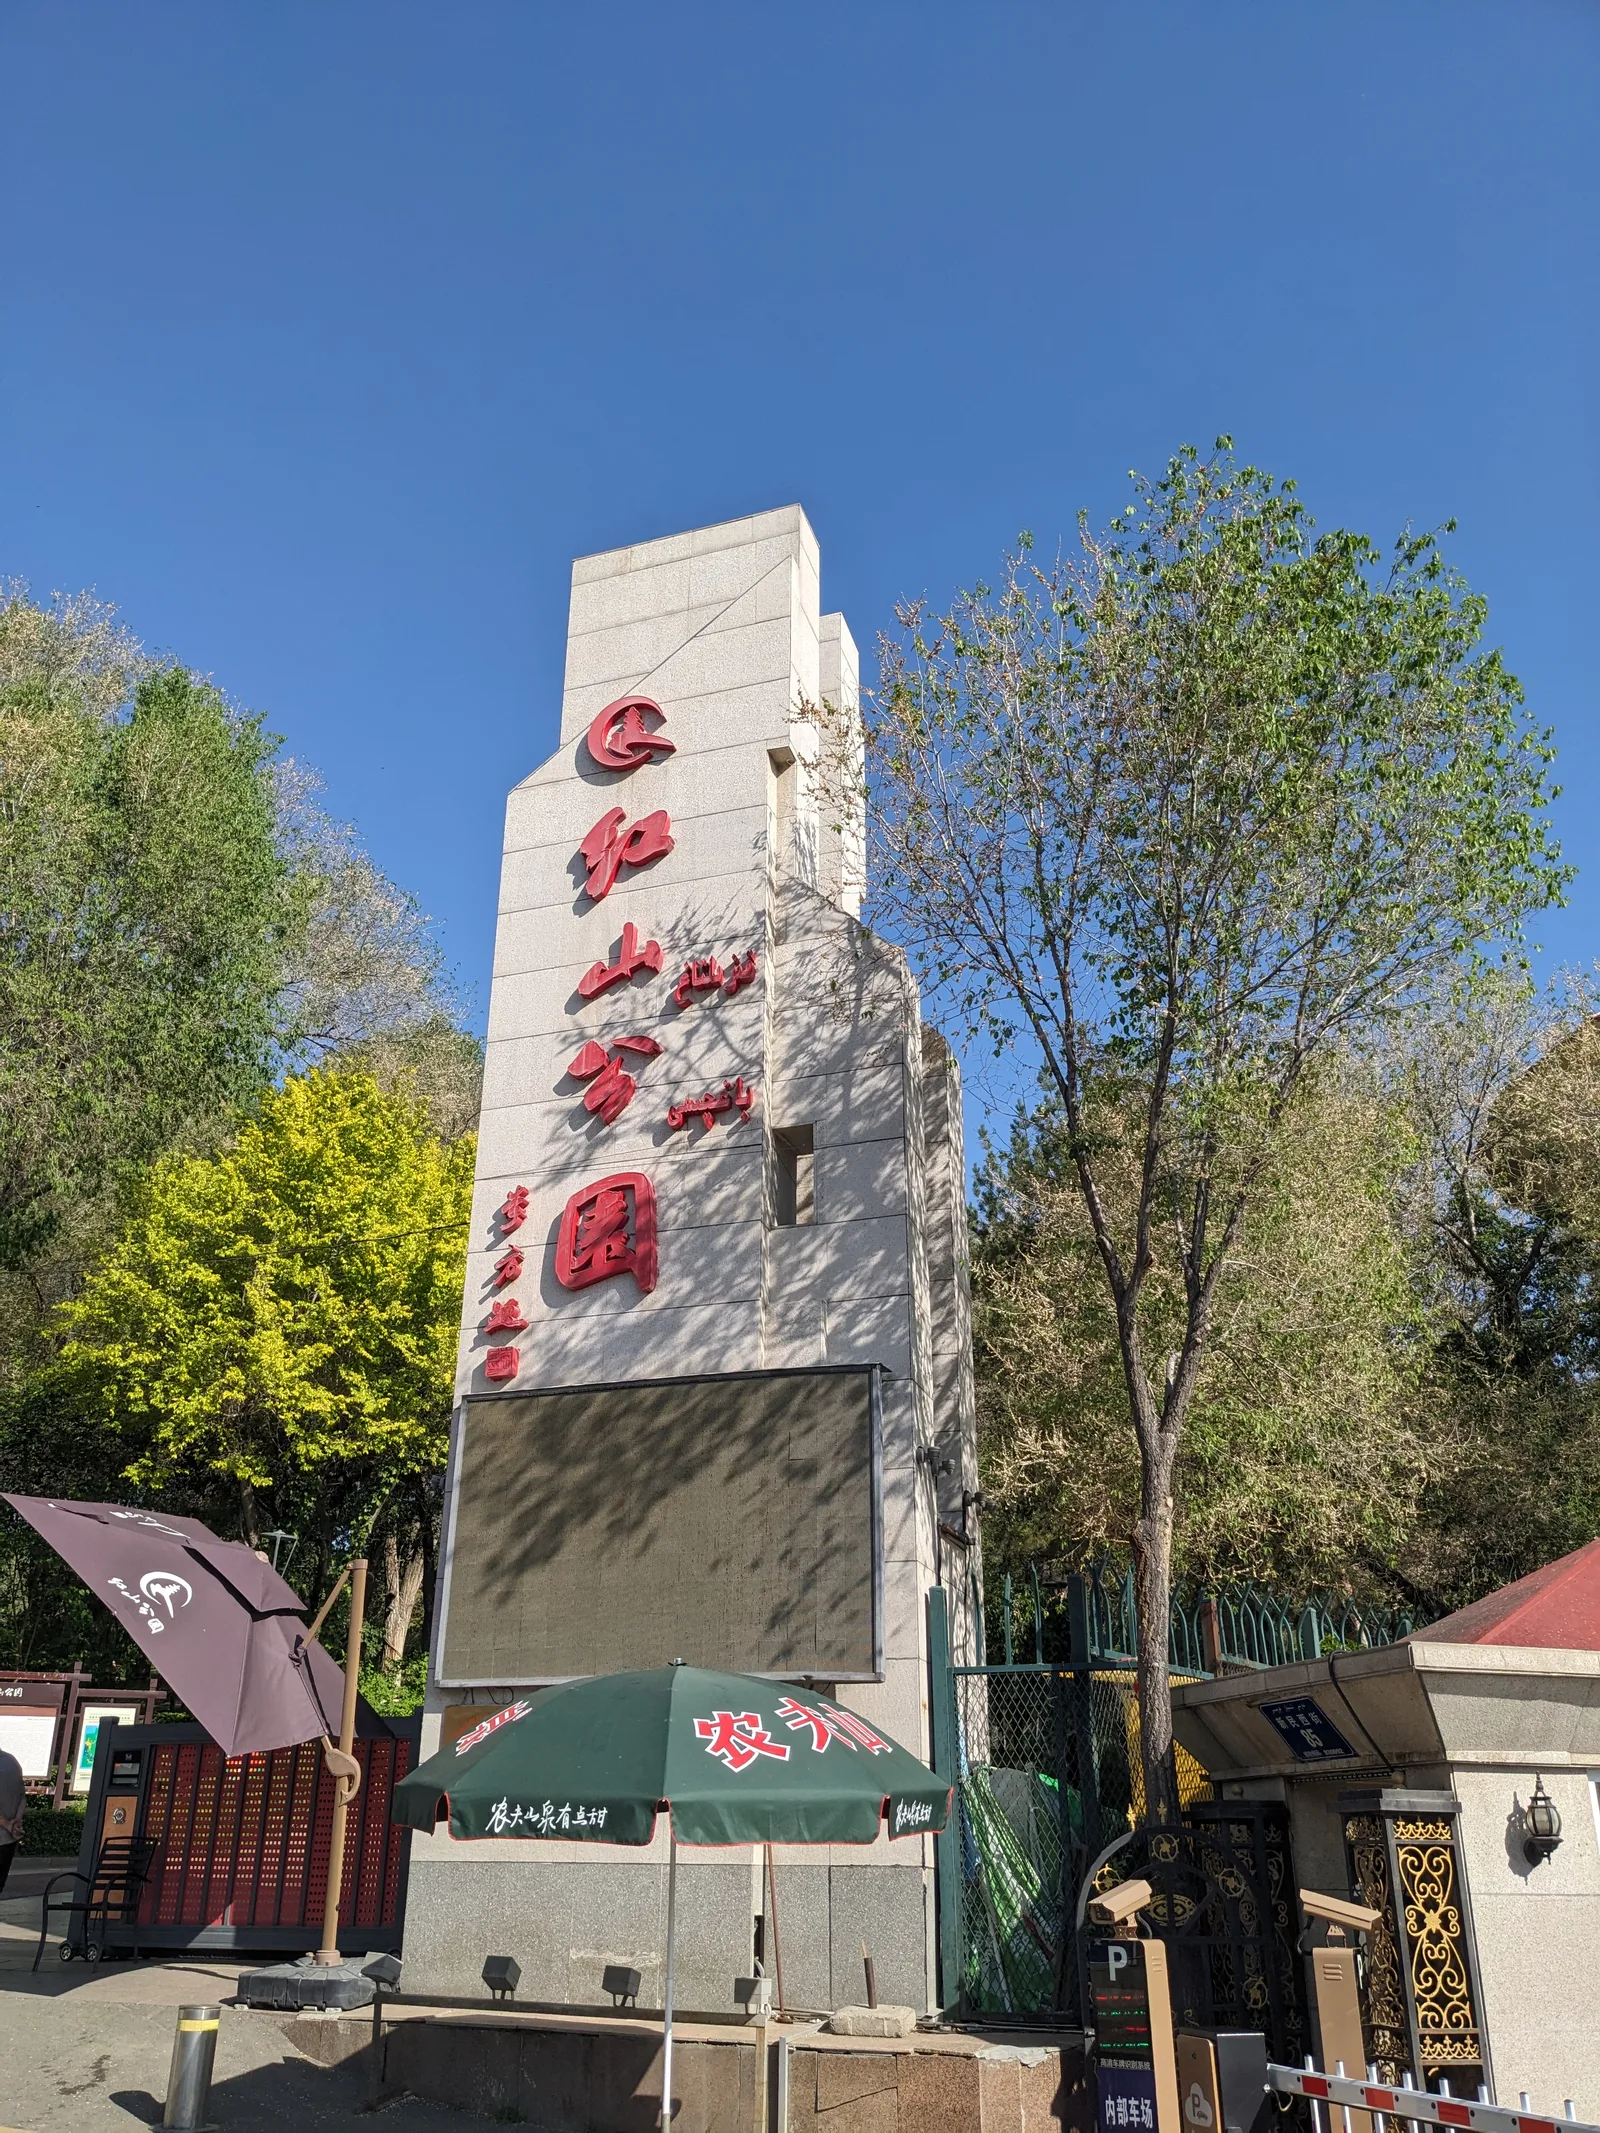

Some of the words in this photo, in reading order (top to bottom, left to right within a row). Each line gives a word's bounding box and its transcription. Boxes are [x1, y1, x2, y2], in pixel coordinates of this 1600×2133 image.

[1300, 1728, 1324, 1748] 85
[485, 1796, 608, 1833] 农夫山泉有点甜
[895, 1797, 932, 1833] 农夫山泉有点甜
[1107, 1945, 1128, 1981] P
[1100, 2057, 1151, 2070] 高清车牌识别系统
[1105, 2094, 1154, 2129] 内部车场
